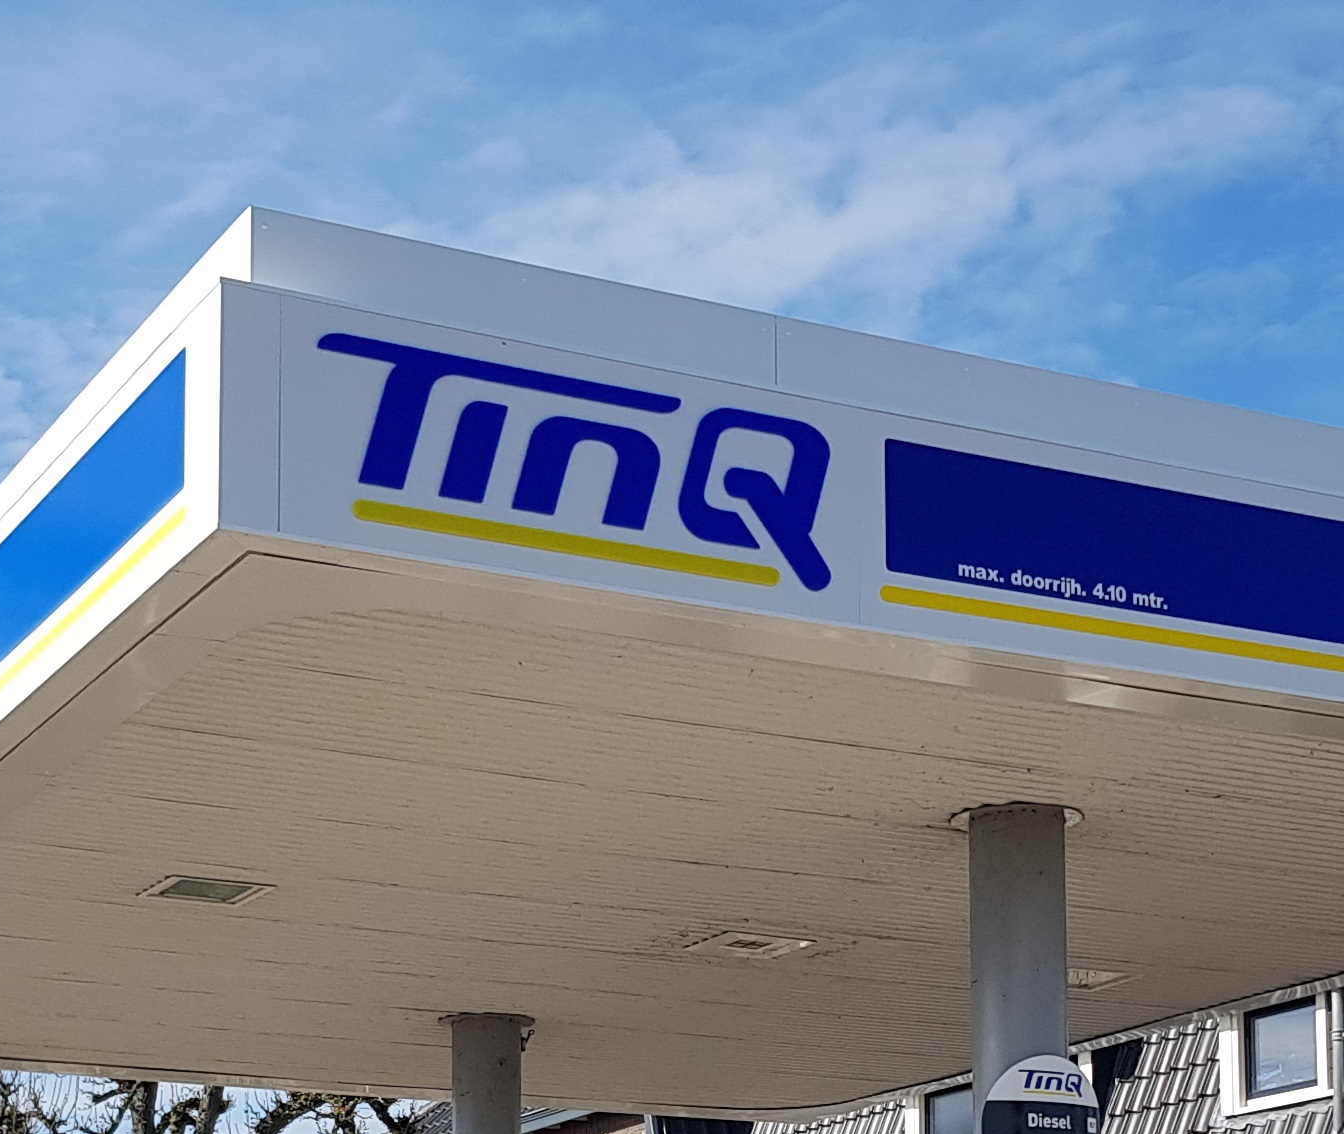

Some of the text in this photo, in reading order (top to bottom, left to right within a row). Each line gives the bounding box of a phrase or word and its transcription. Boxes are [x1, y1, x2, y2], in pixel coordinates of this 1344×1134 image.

[958, 563, 1168, 610] max. doorrijh. 4.10 mtr.
[1027, 1112, 1072, 1130] Diesel
